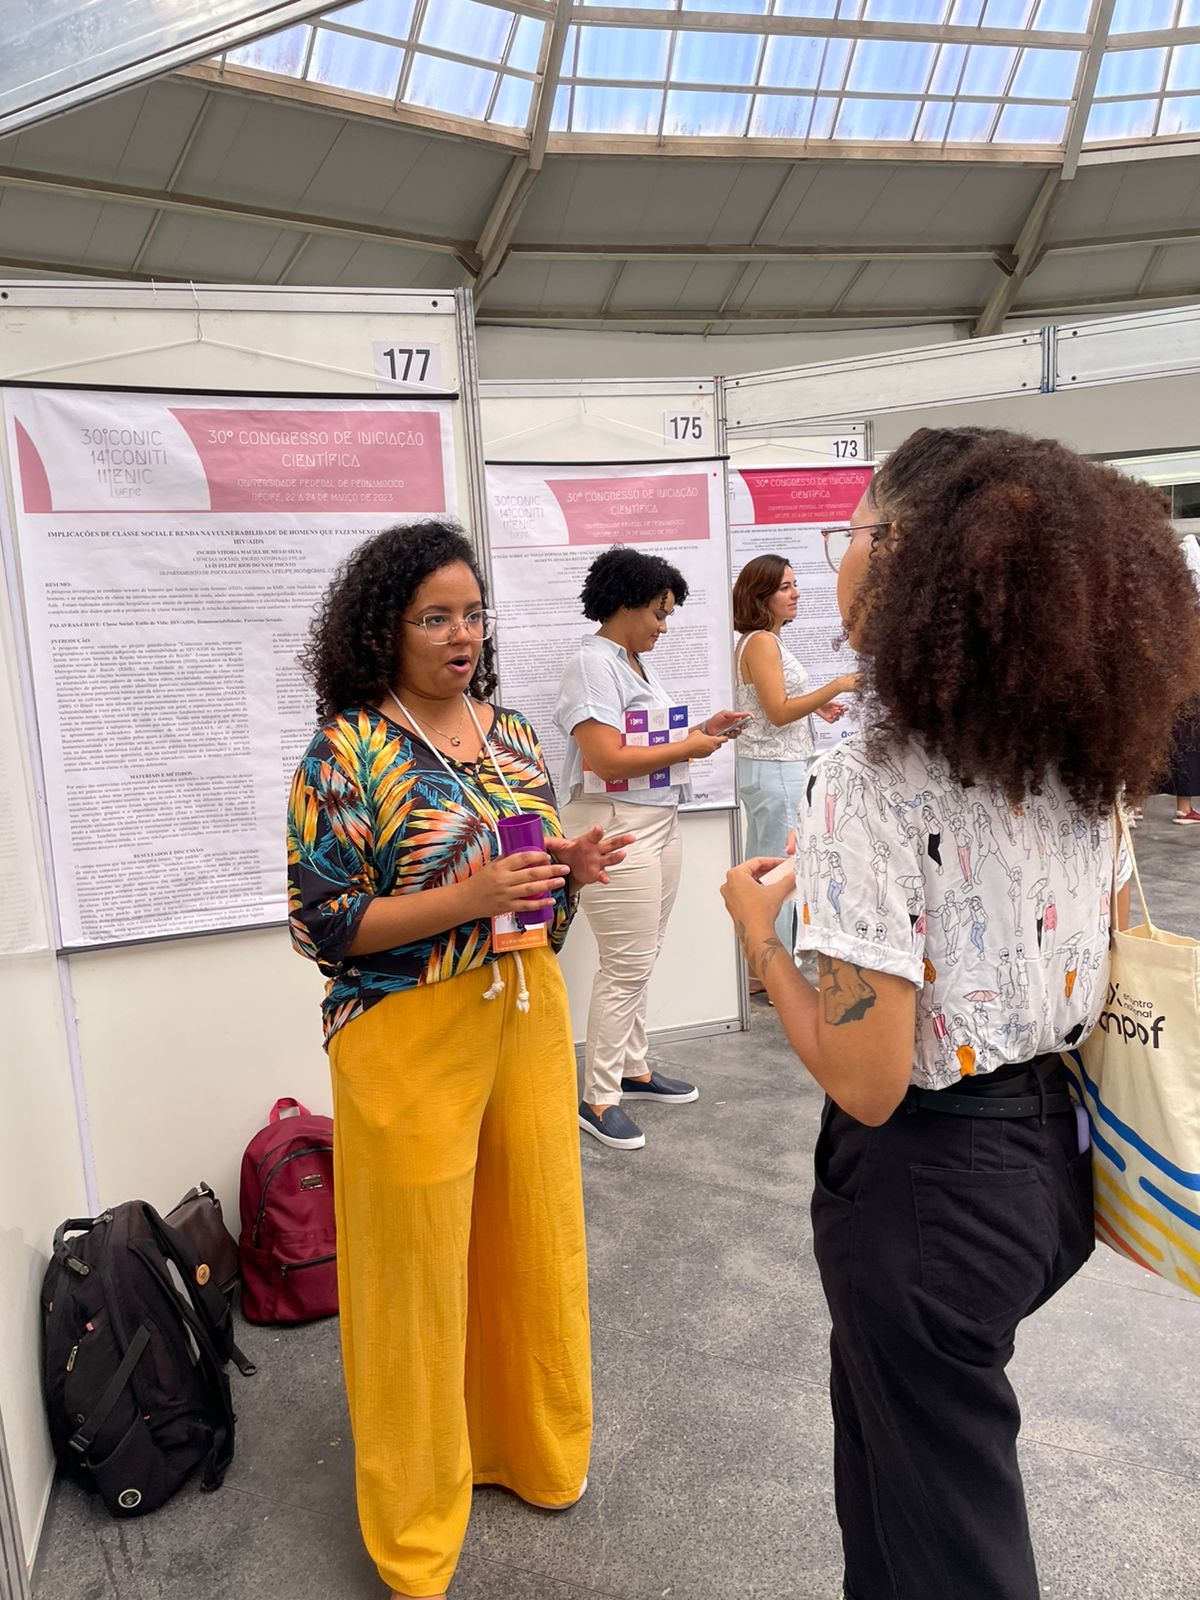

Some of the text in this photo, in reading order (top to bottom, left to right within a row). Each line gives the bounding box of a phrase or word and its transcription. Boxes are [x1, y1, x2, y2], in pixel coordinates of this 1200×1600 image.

[383, 348, 430, 381] 177
[670, 416, 702, 439] 175
[239, 431, 329, 446] CONGRESSO
[333, 431, 353, 445] DE
[357, 430, 424, 448] INICIAÇÃO
[833, 440, 858, 458] 173
[281, 451, 361, 468] CIENTÍFICA
[338, 479, 349, 488] DE
[586, 489, 640, 502] CONGRESSO
[642, 489, 654, 499] DE
[656, 486, 699, 499] INICIAÇÃO
[610, 502, 658, 515] CIENTÍFICA
[47, 529, 100, 538] IMPLICAÇÕES
[289, 529, 319, 537] HOMENS
[319, 529, 333, 537] QUE
